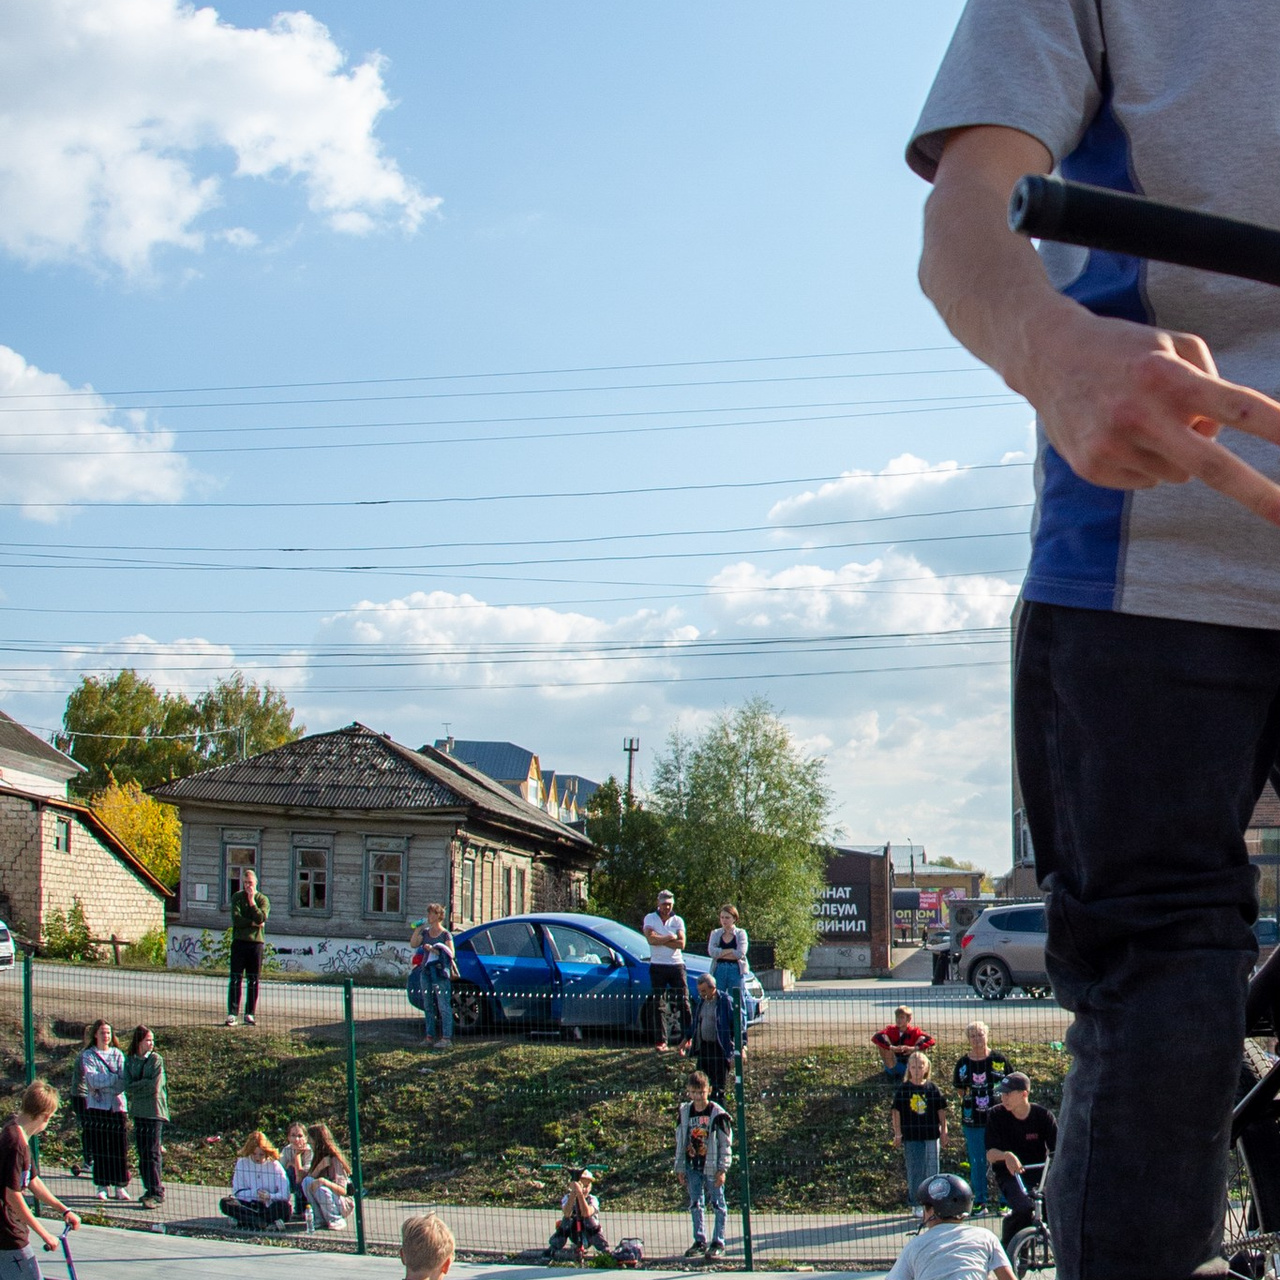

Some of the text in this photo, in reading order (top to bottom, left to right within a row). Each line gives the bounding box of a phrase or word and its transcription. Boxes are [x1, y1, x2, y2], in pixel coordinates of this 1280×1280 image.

[812, 886, 852, 899] ИНАТ
[808, 903, 857, 917] ОЛЕУМ
[895, 909, 936, 918] ОПОМ
